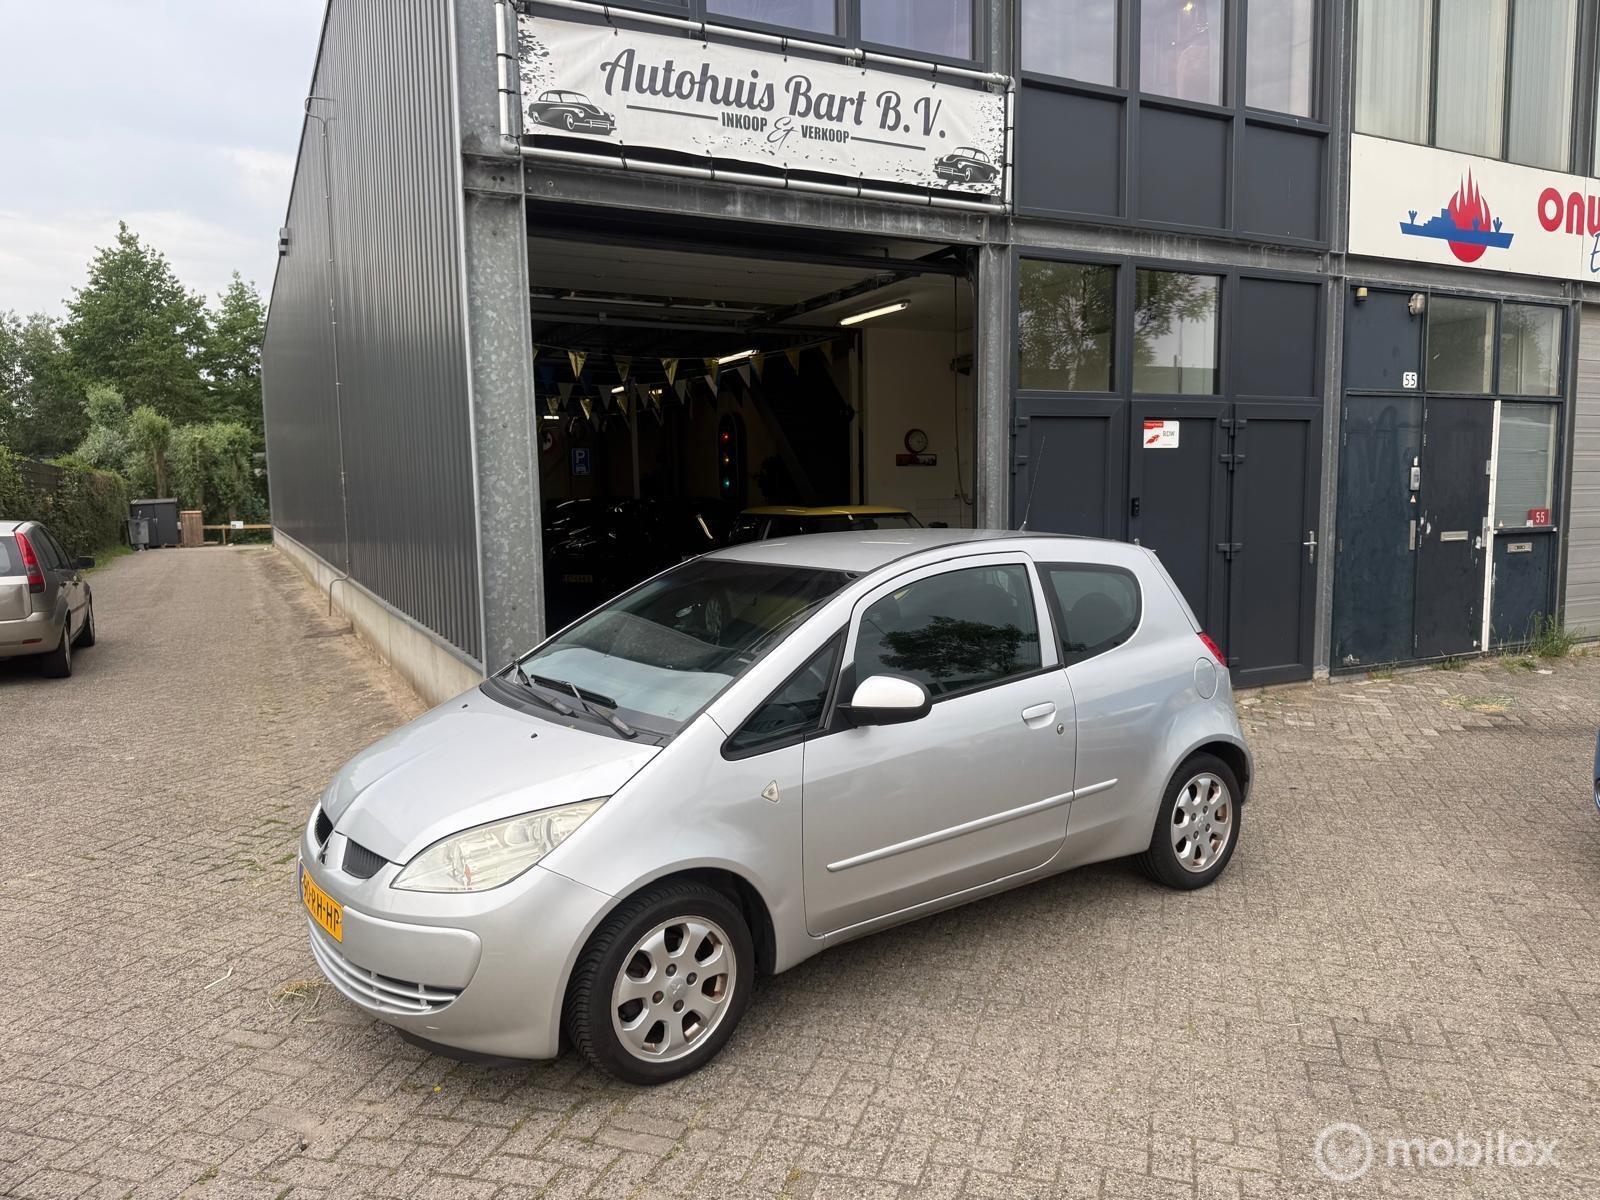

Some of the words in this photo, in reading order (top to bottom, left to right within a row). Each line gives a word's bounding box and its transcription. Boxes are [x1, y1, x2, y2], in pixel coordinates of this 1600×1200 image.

[600, 48, 775, 112] Autohuis
[785, 75, 866, 126] Bart
[876, 90, 946, 139] B.V.
[721, 111, 767, 132] INKOOP
[801, 124, 850, 144] VERKOOP
[1404, 374, 1416, 386] 55
[1535, 511, 1545, 523] 55
